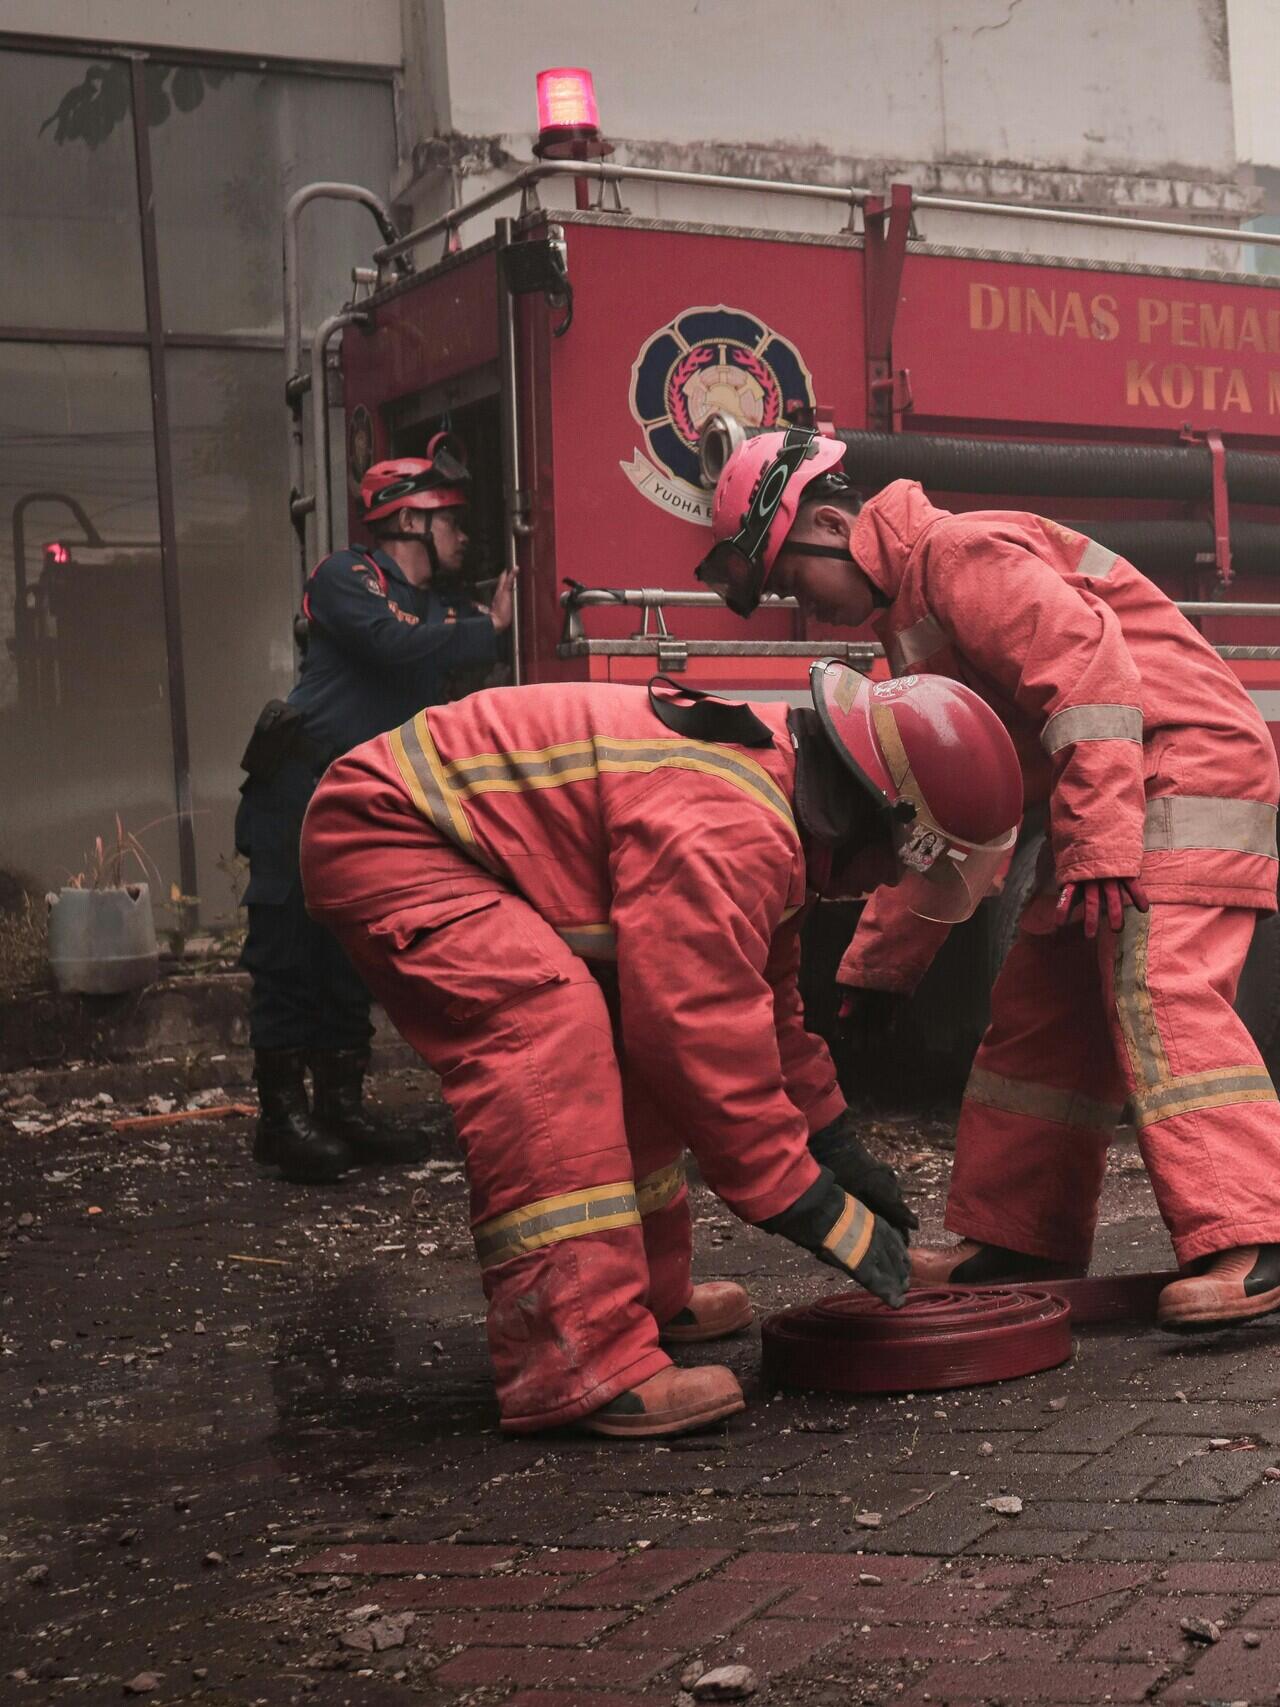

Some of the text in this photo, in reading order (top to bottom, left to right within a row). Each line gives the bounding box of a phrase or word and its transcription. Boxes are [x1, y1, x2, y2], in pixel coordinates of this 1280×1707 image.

[969, 283, 1120, 341] DINAS
[1126, 360, 1252, 413] KOTA
[654, 483, 701, 516] YUDHA
